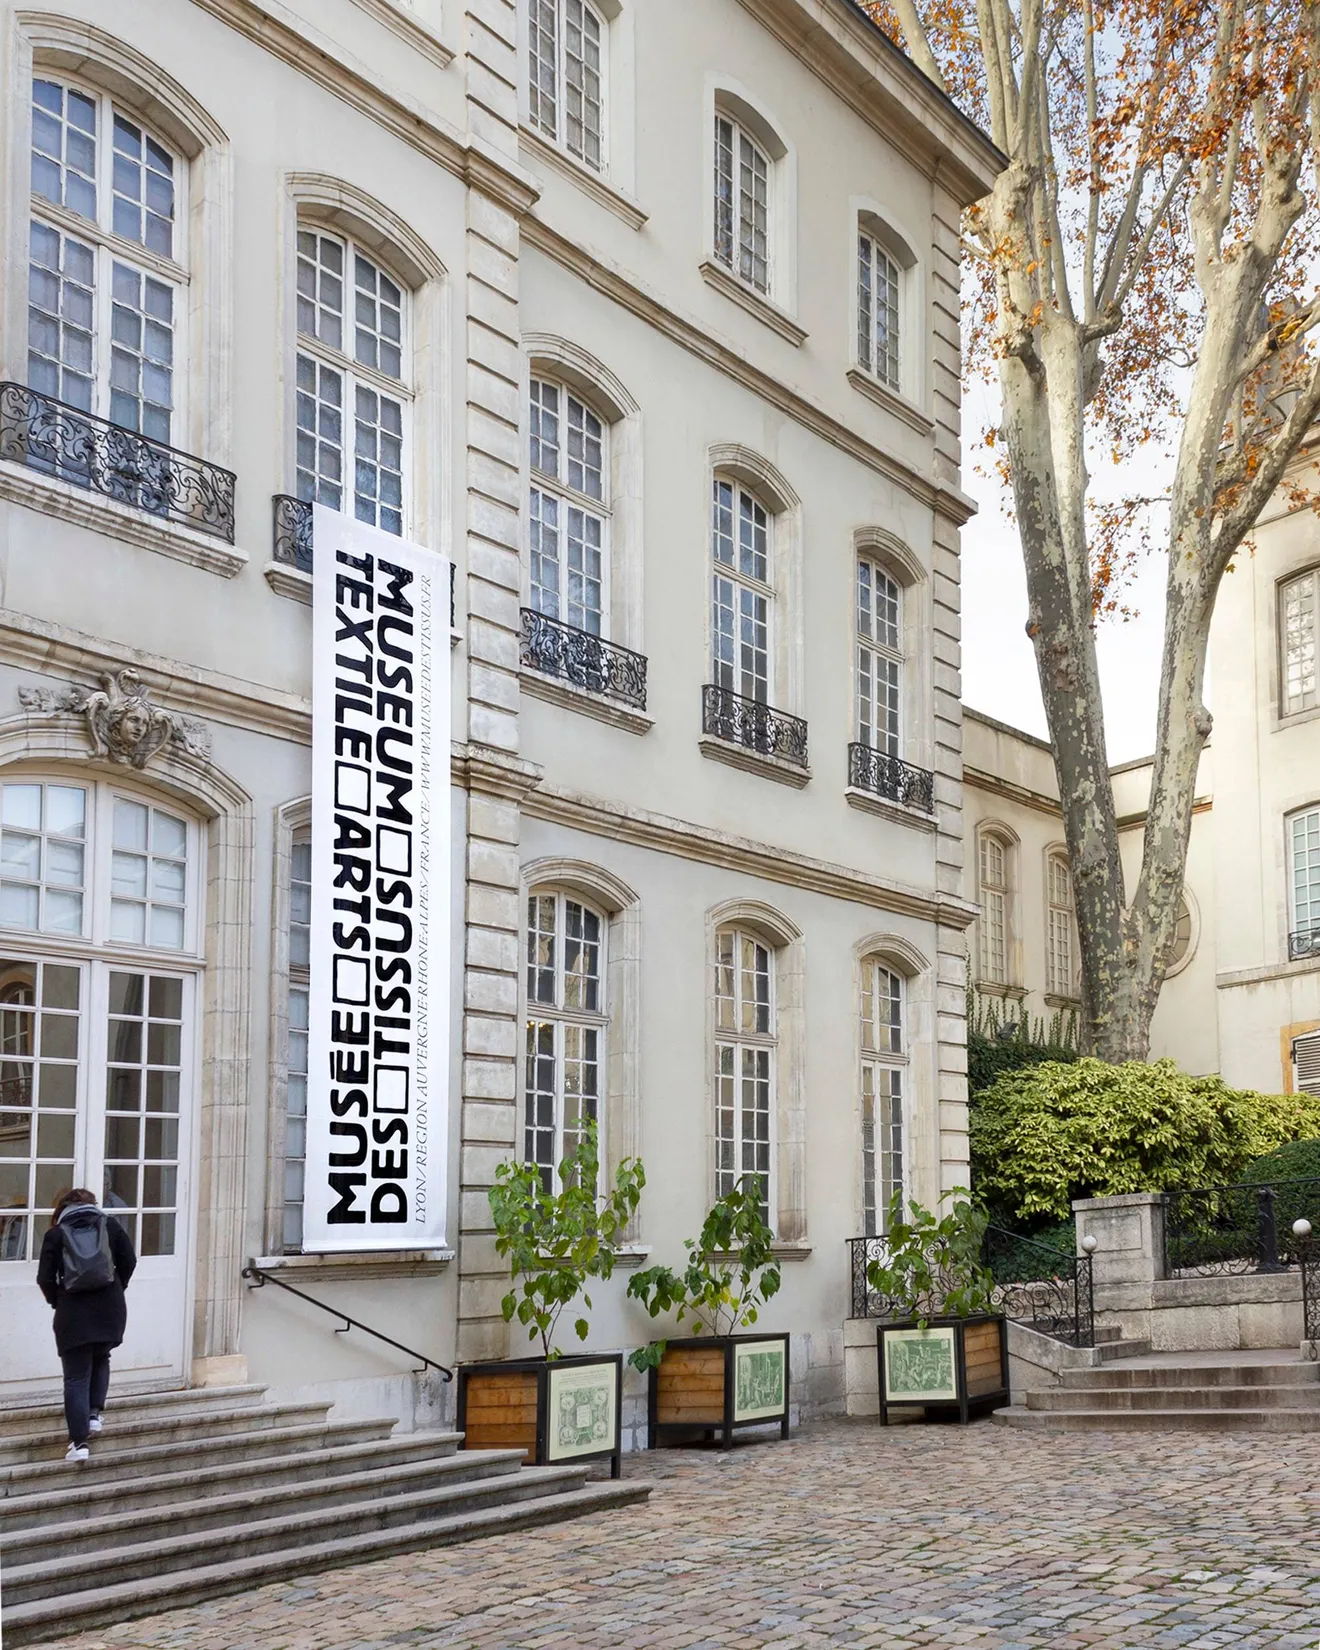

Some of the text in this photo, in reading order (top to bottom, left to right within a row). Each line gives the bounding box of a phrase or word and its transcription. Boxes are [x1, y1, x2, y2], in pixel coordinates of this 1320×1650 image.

[333, 550, 373, 951] TEXTILE ARTS
[376, 558, 413, 825] MUSEUM
[327, 1010, 370, 1224] MUSÉE
[371, 878, 412, 1223] DES TISSUS
